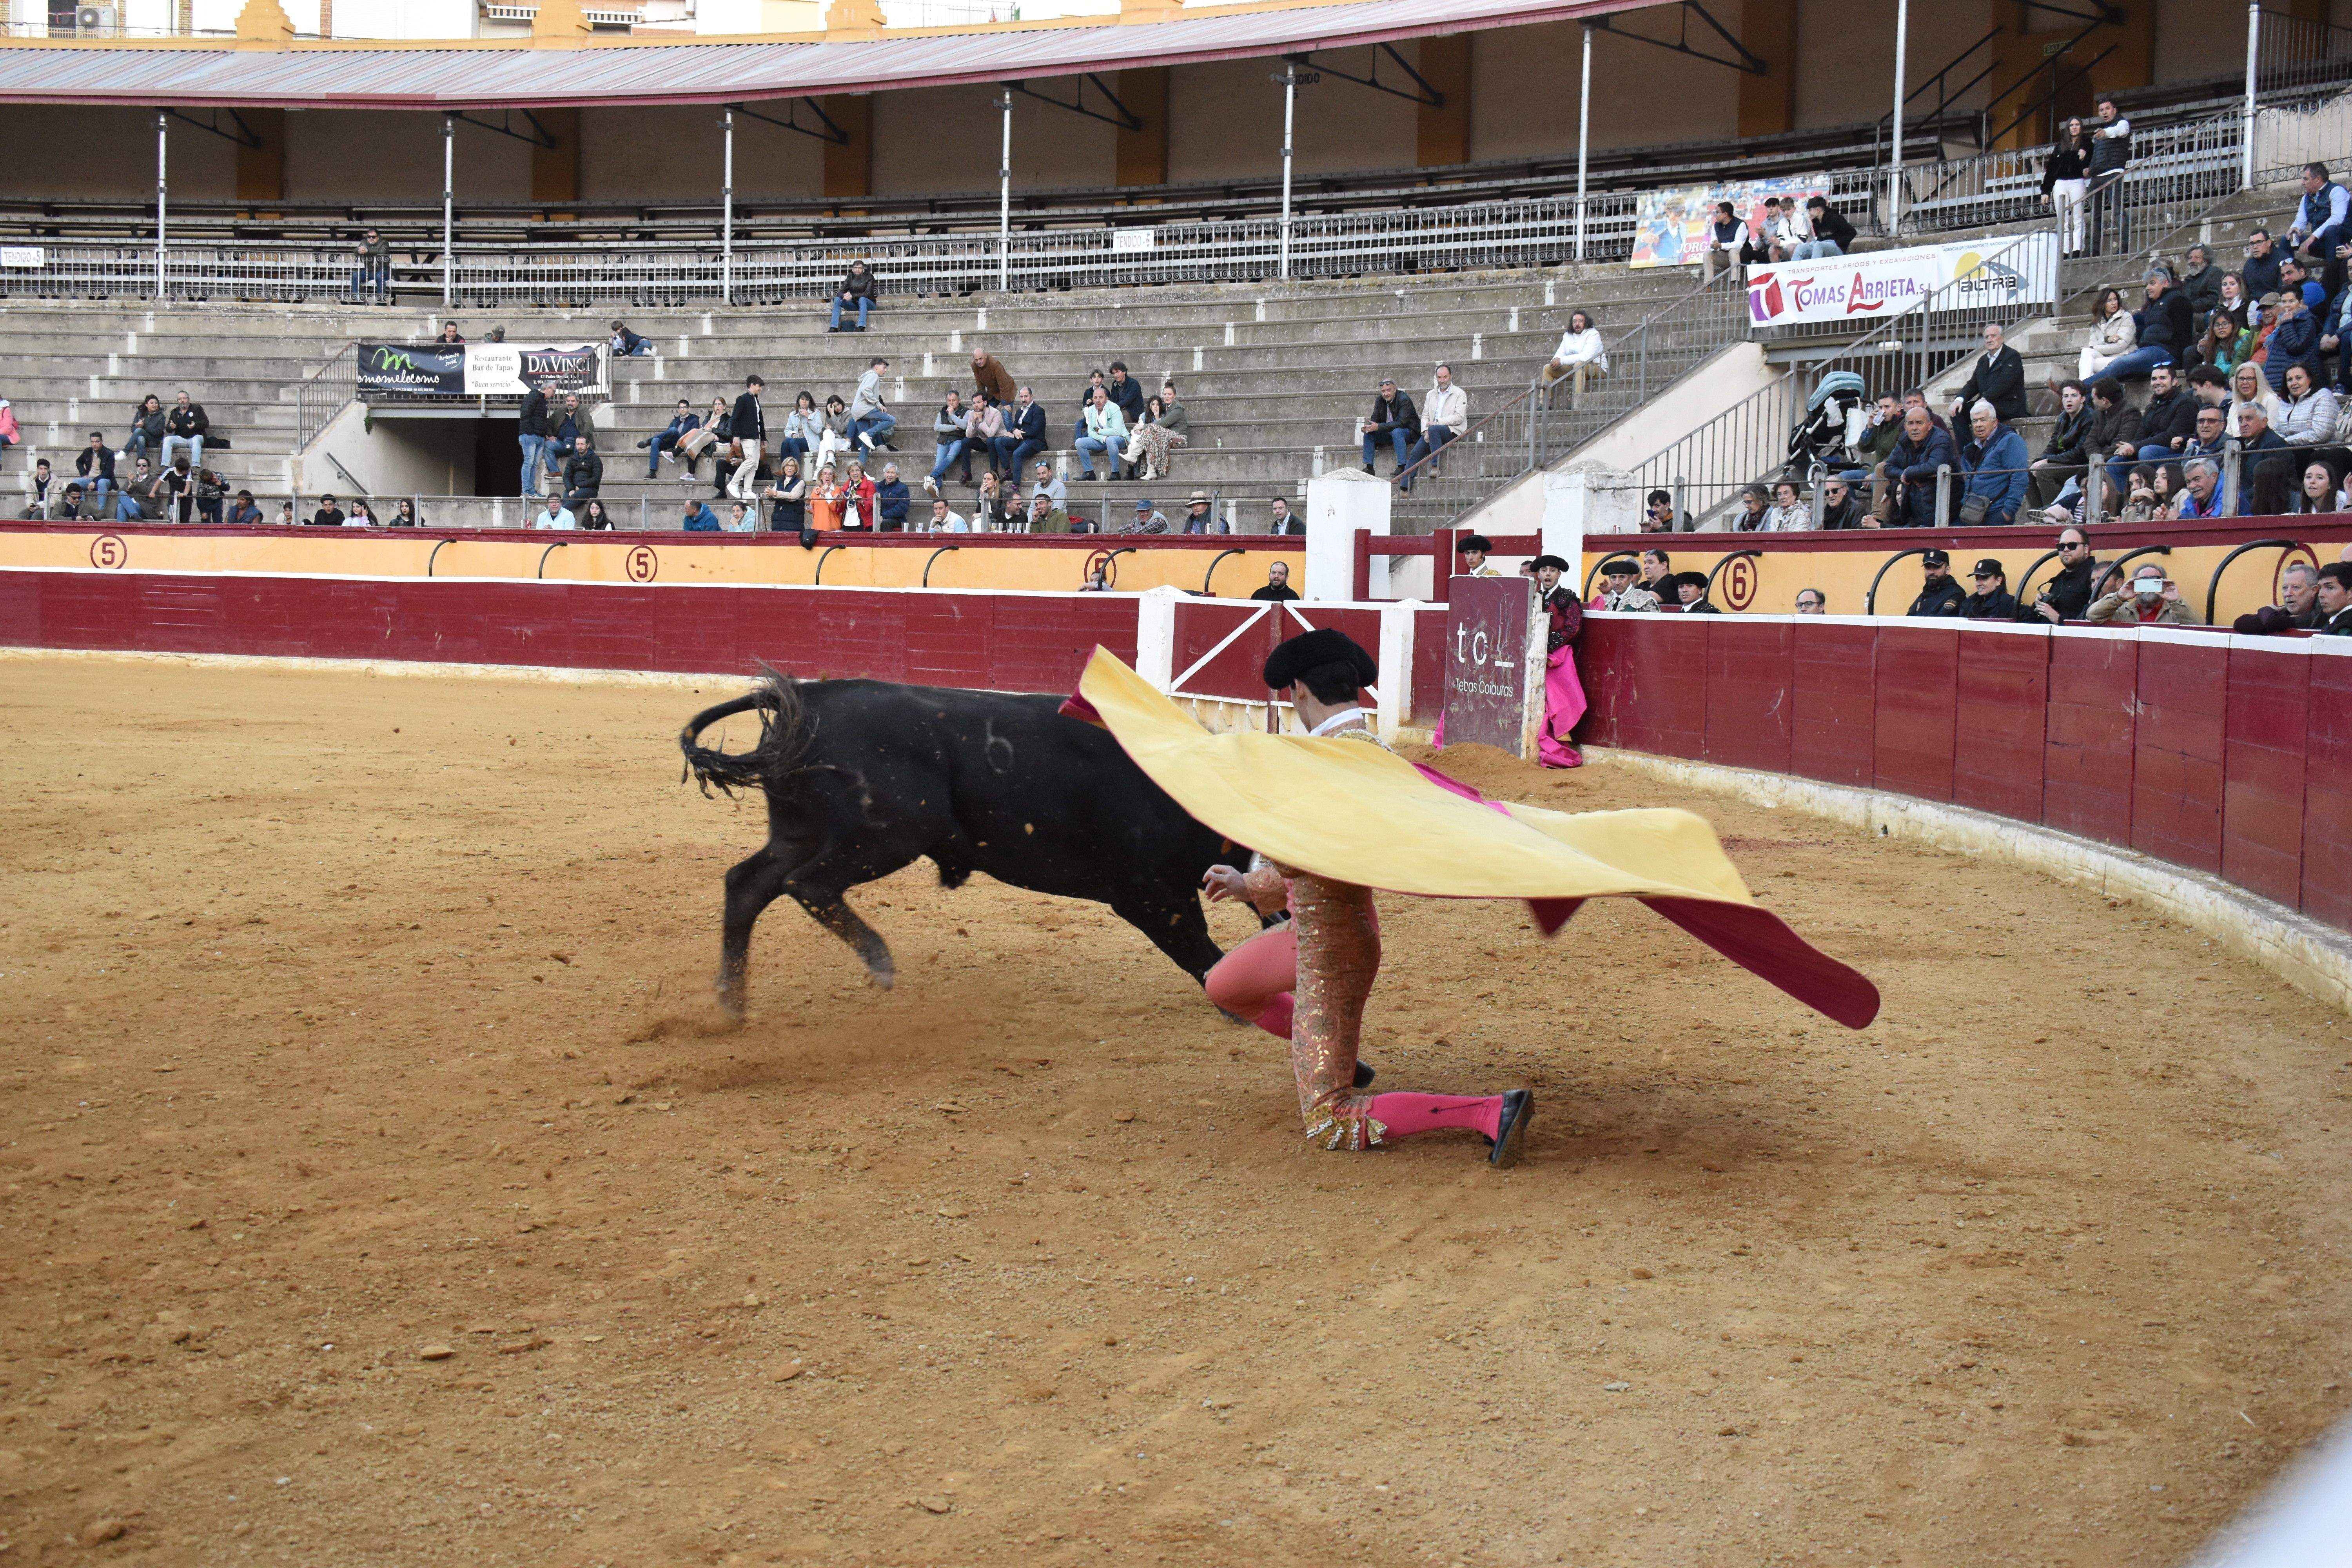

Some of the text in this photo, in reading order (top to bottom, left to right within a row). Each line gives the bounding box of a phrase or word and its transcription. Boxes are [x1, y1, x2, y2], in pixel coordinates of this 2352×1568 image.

[1116, 236, 1142, 248] TENDIDO
[1676, 241, 1711, 253] JORG
[36, 250, 40, 263] 5
[1788, 265, 1840, 275] TRANSPORTES,
[1879, 253, 1936, 265] EXCAVACIONES
[1787, 277, 1844, 312] TOMAS
[439, 352, 459, 361] Ambiente
[528, 356, 590, 372] DA VINCI
[495, 364, 514, 372] Tapas
[102, 543, 116, 565] 5
[636, 553, 648, 578] 5
[1733, 563, 1747, 601] 6
[1455, 678, 1477, 693] Tebas
[985, 718, 1014, 775] 6
